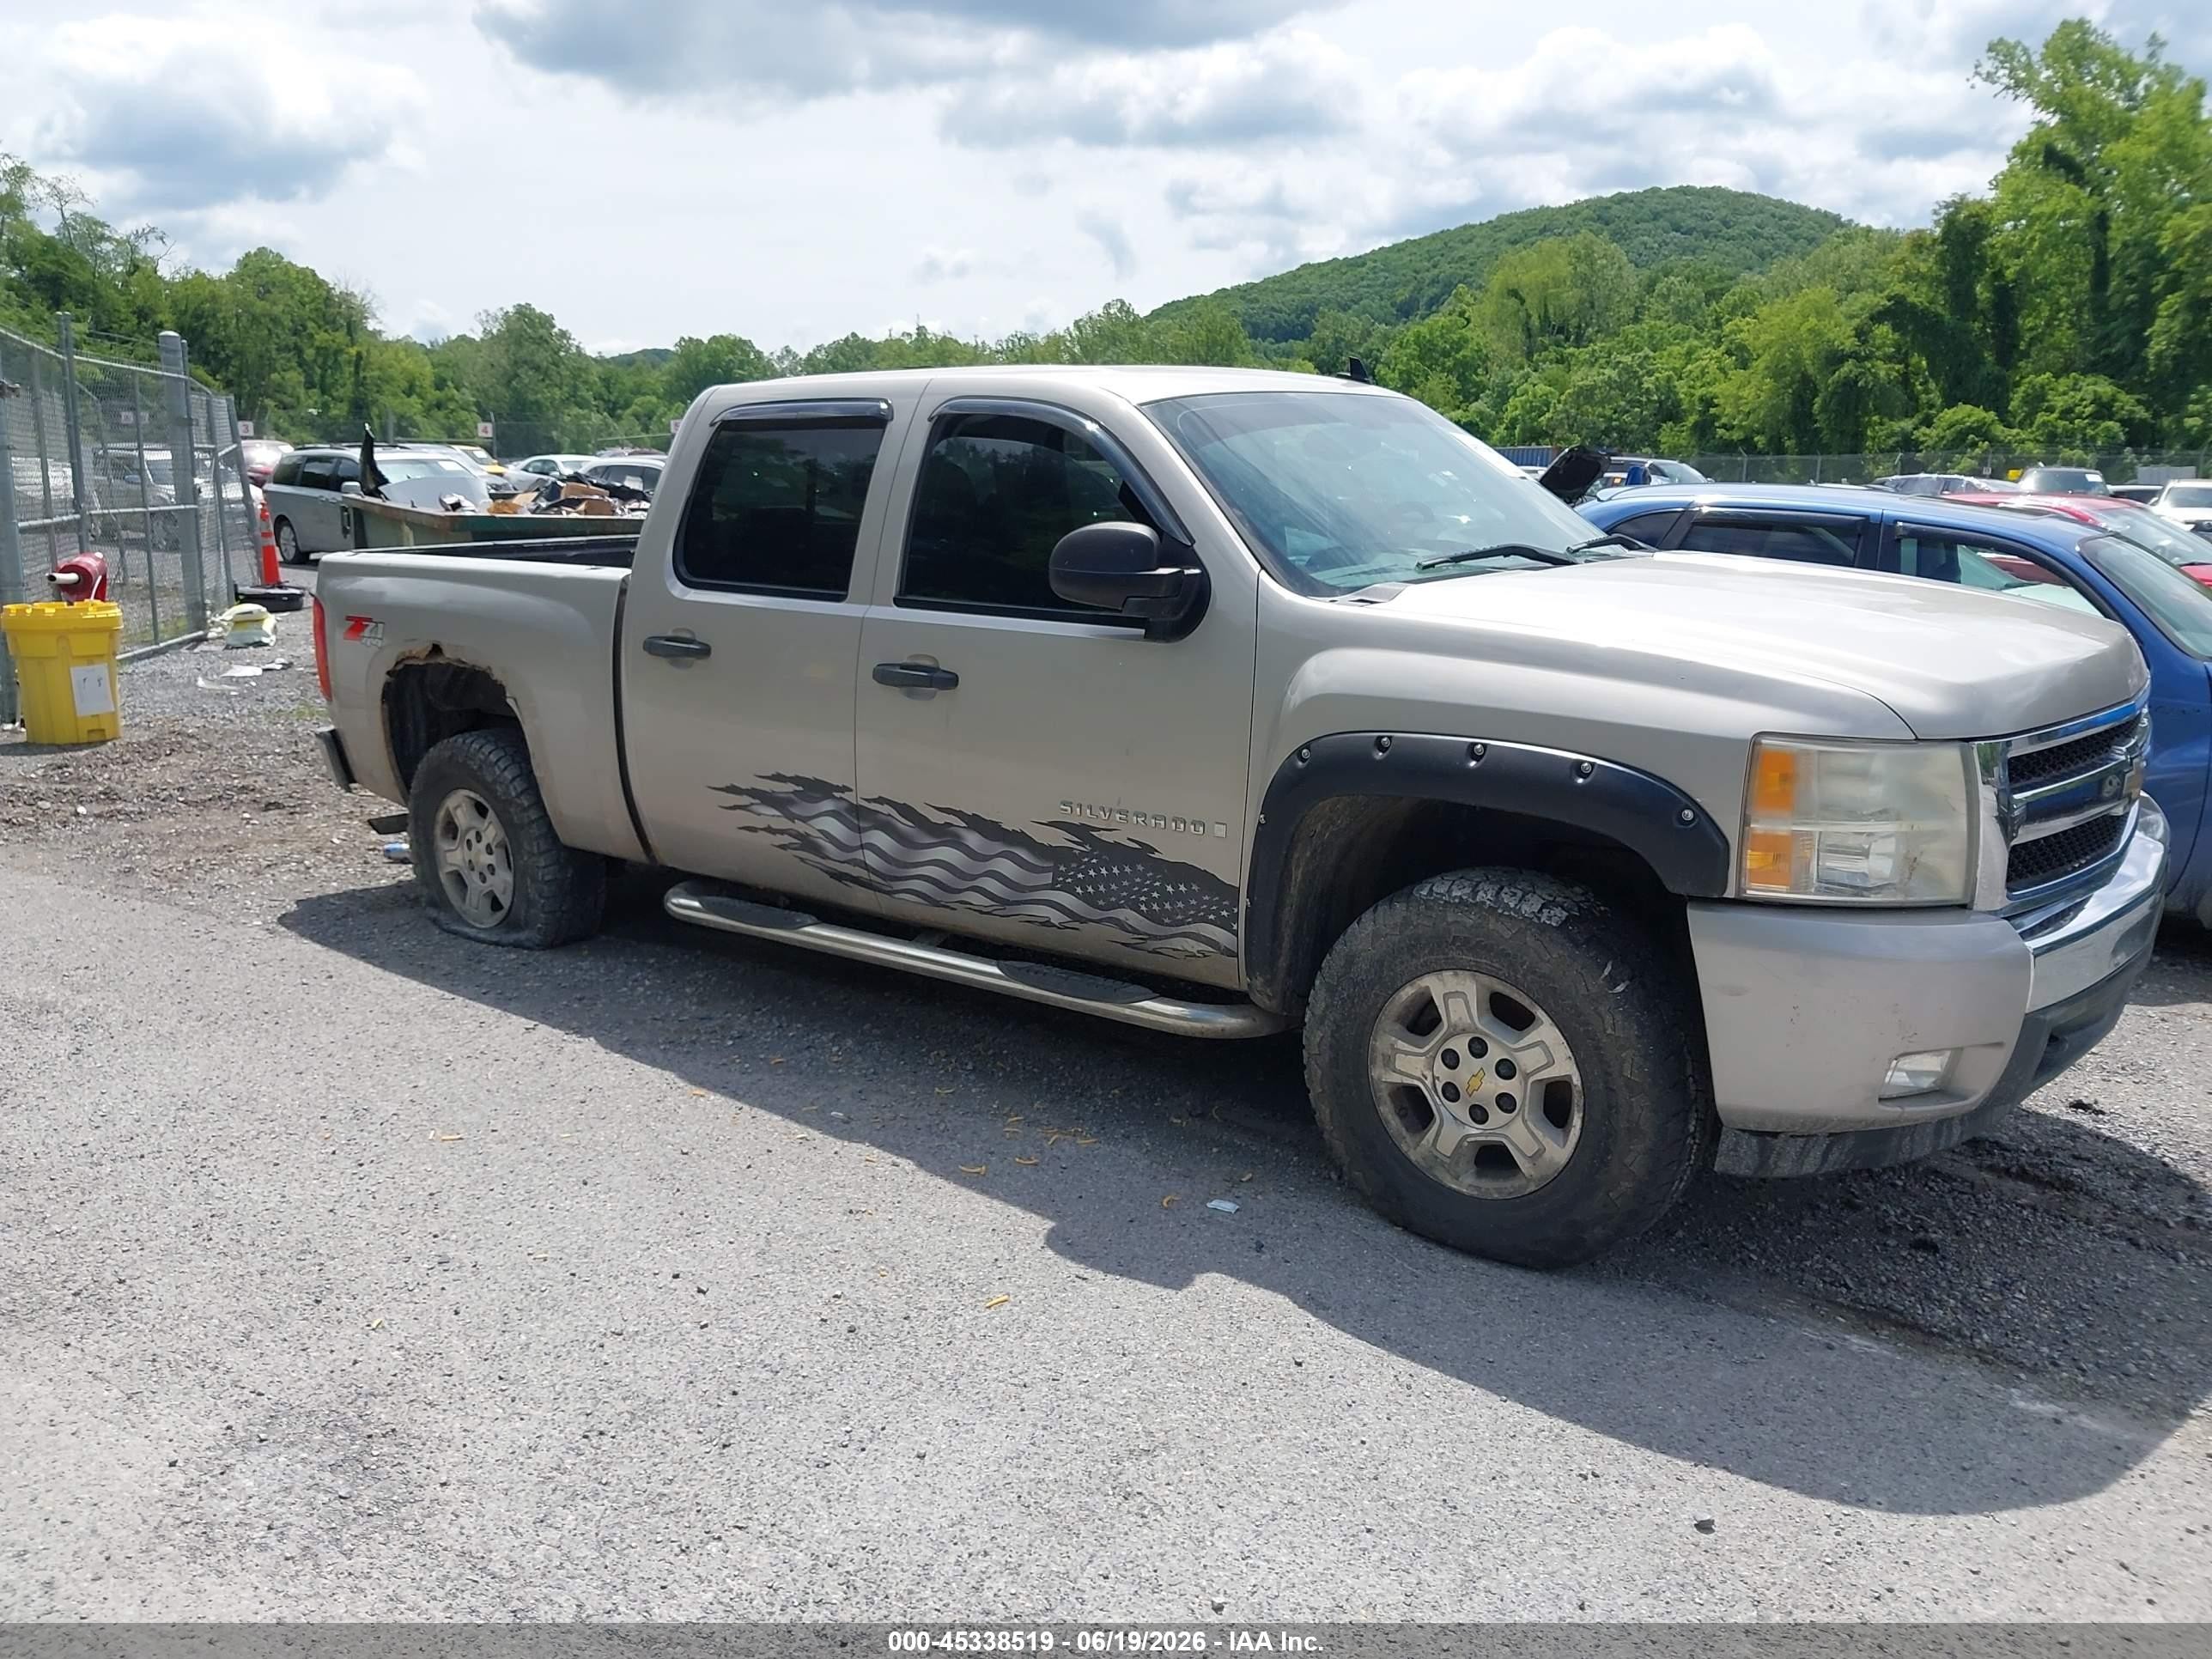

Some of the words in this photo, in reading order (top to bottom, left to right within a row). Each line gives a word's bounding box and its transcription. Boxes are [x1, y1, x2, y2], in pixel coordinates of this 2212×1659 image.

[241, 423, 249, 434] 3
[480, 425, 489, 434] 4
[1059, 799, 1206, 836] SILVERADO
